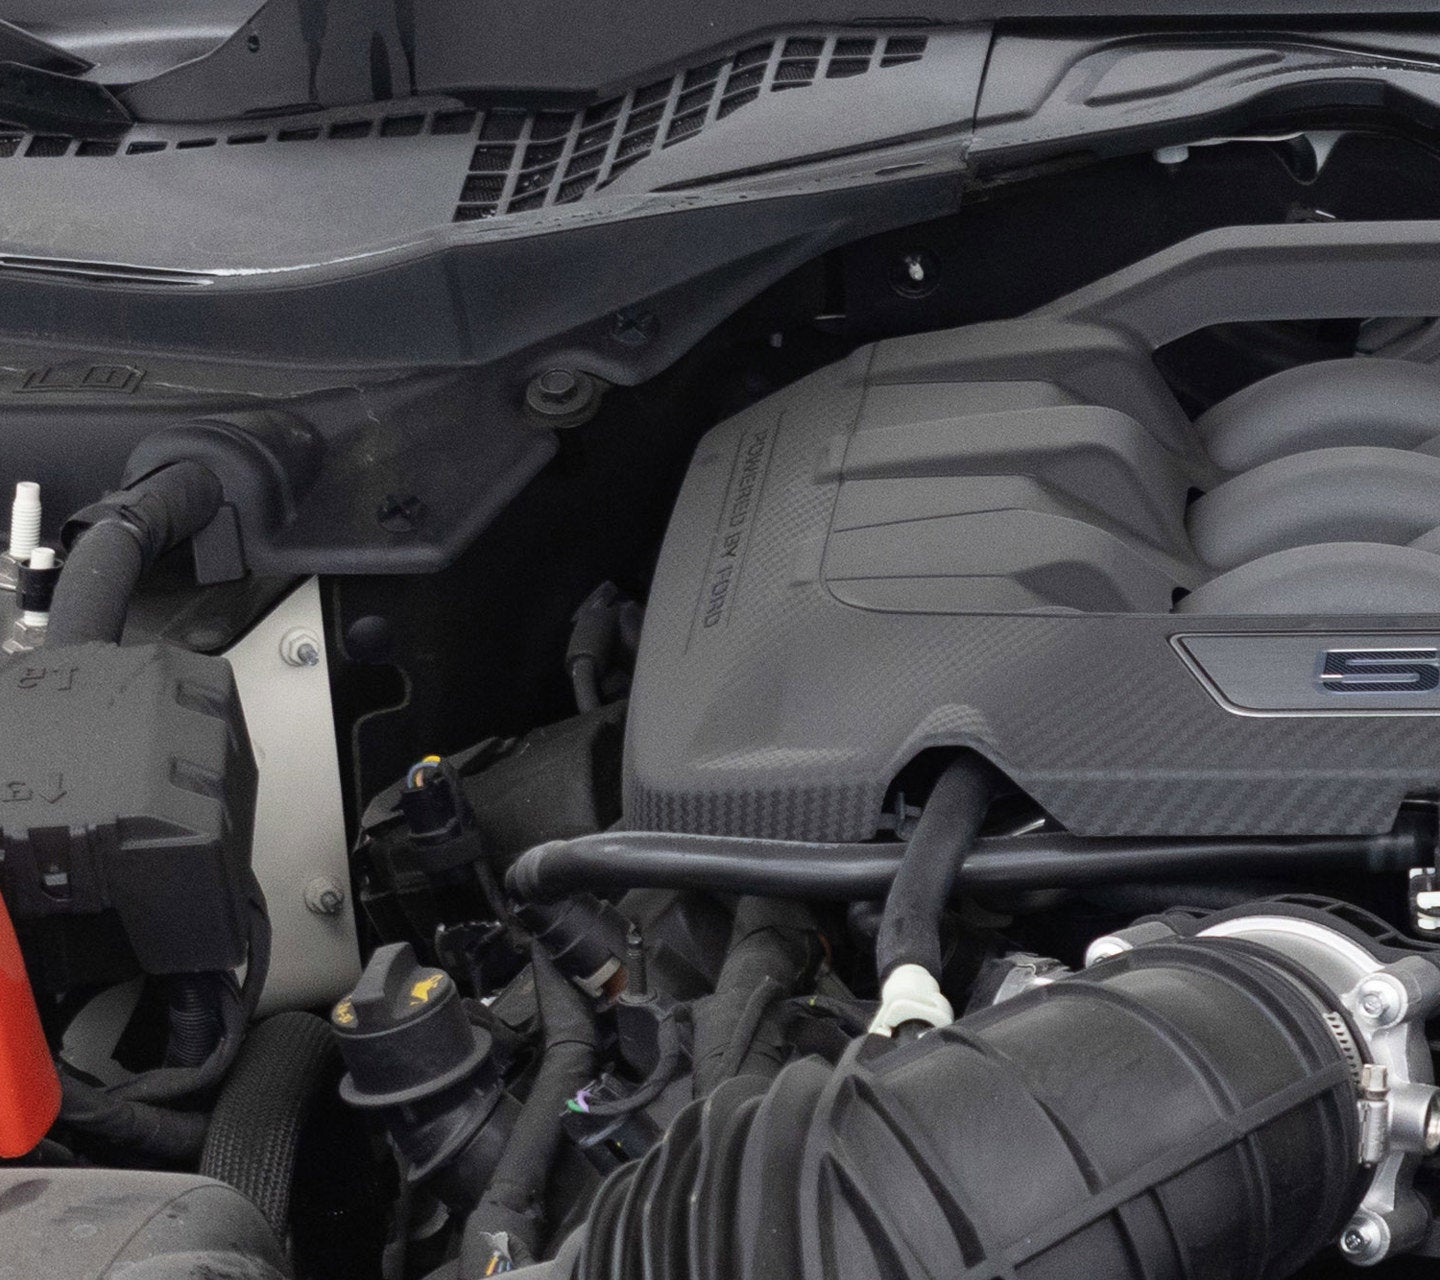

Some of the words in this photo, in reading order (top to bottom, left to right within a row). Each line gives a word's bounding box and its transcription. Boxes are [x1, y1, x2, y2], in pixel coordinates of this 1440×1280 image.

[729, 429, 769, 529] POWERED
[721, 532, 742, 558] BY
[703, 565, 732, 629] FORD
